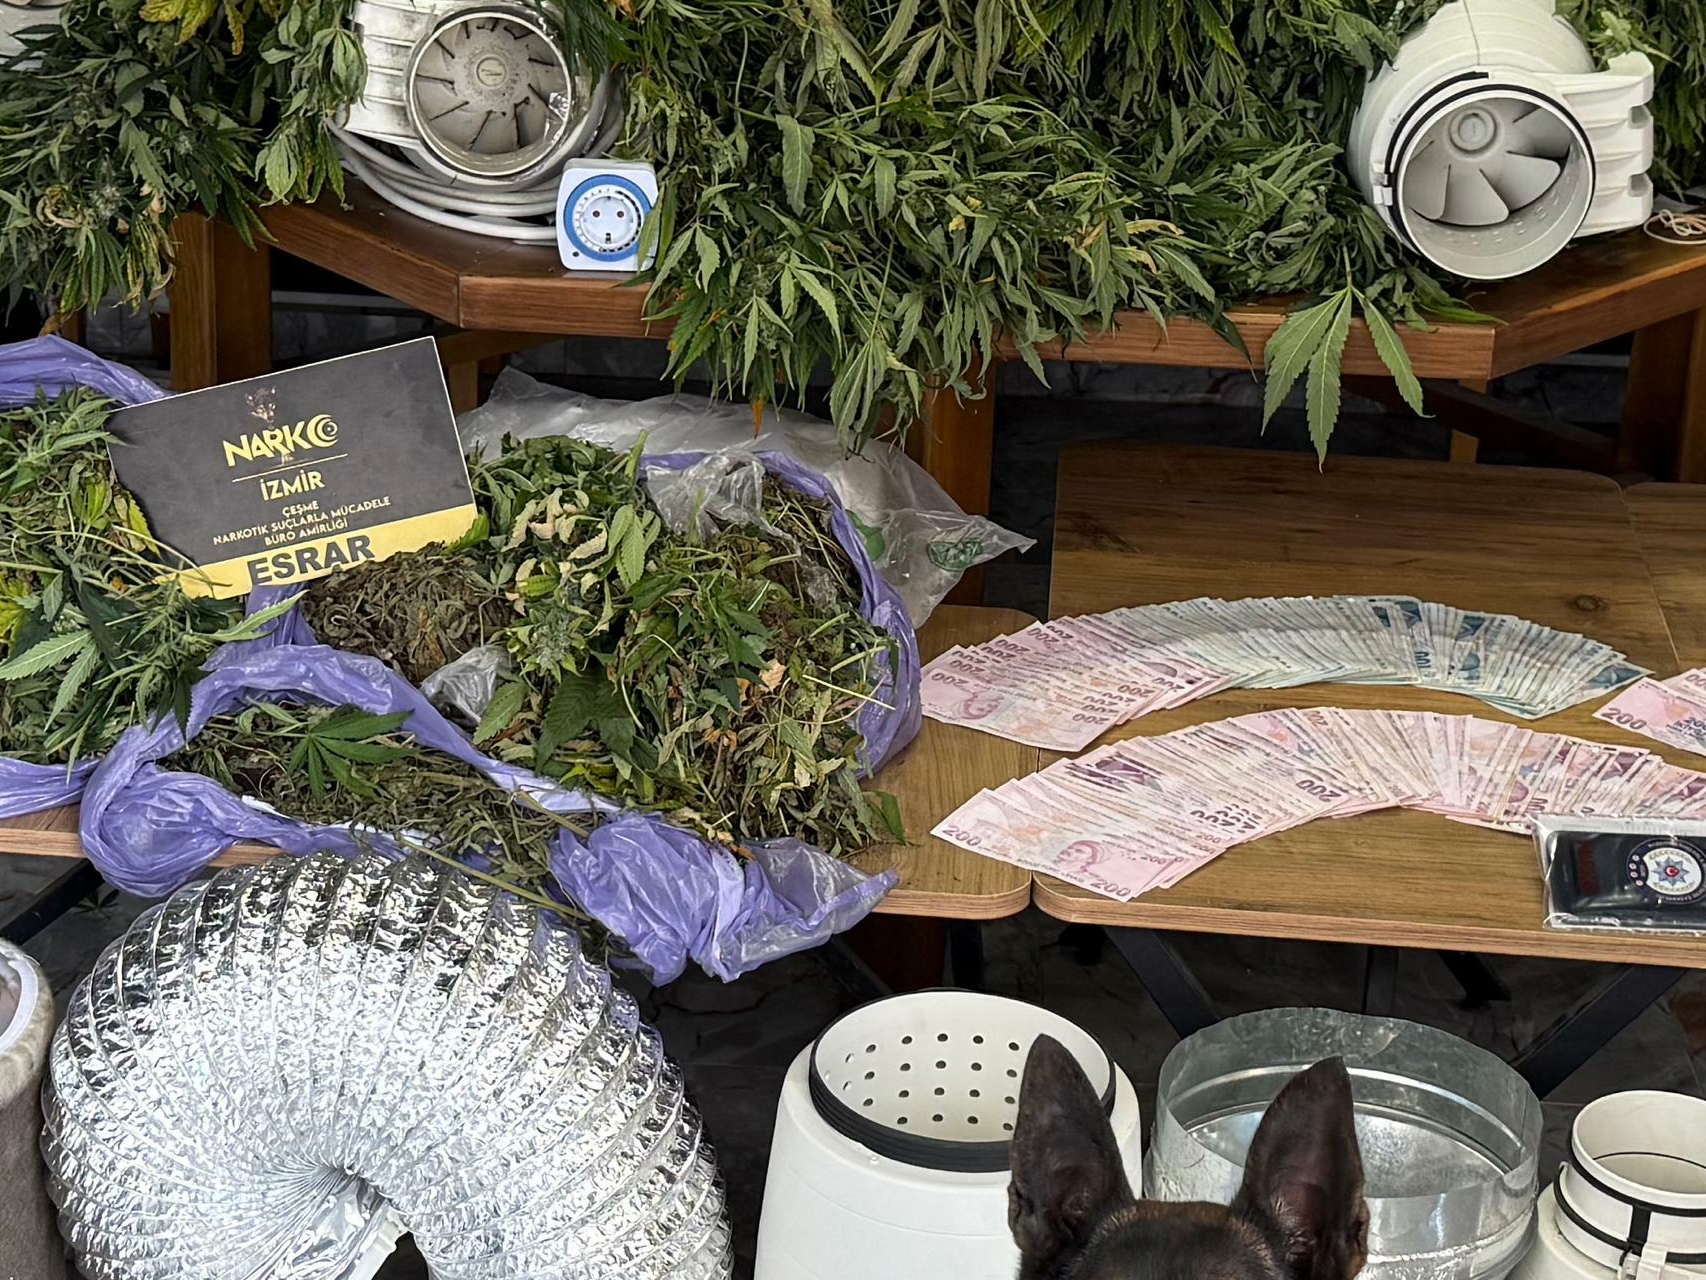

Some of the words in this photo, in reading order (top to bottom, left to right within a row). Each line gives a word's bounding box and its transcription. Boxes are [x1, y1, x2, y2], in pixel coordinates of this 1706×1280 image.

[222, 414, 339, 467] NARKO
[260, 470, 325, 501] İZMİR
[282, 500, 320, 518] ÇEŞME
[213, 525, 269, 546] NARKOTİK
[271, 511, 329, 532] SUÇLARLA
[247, 535, 375, 584] ESRAR
[1601, 707, 1648, 730] 200
[1296, 779, 1342, 803] 200
[942, 825, 983, 848] 200
[1092, 878, 1133, 898] 200
